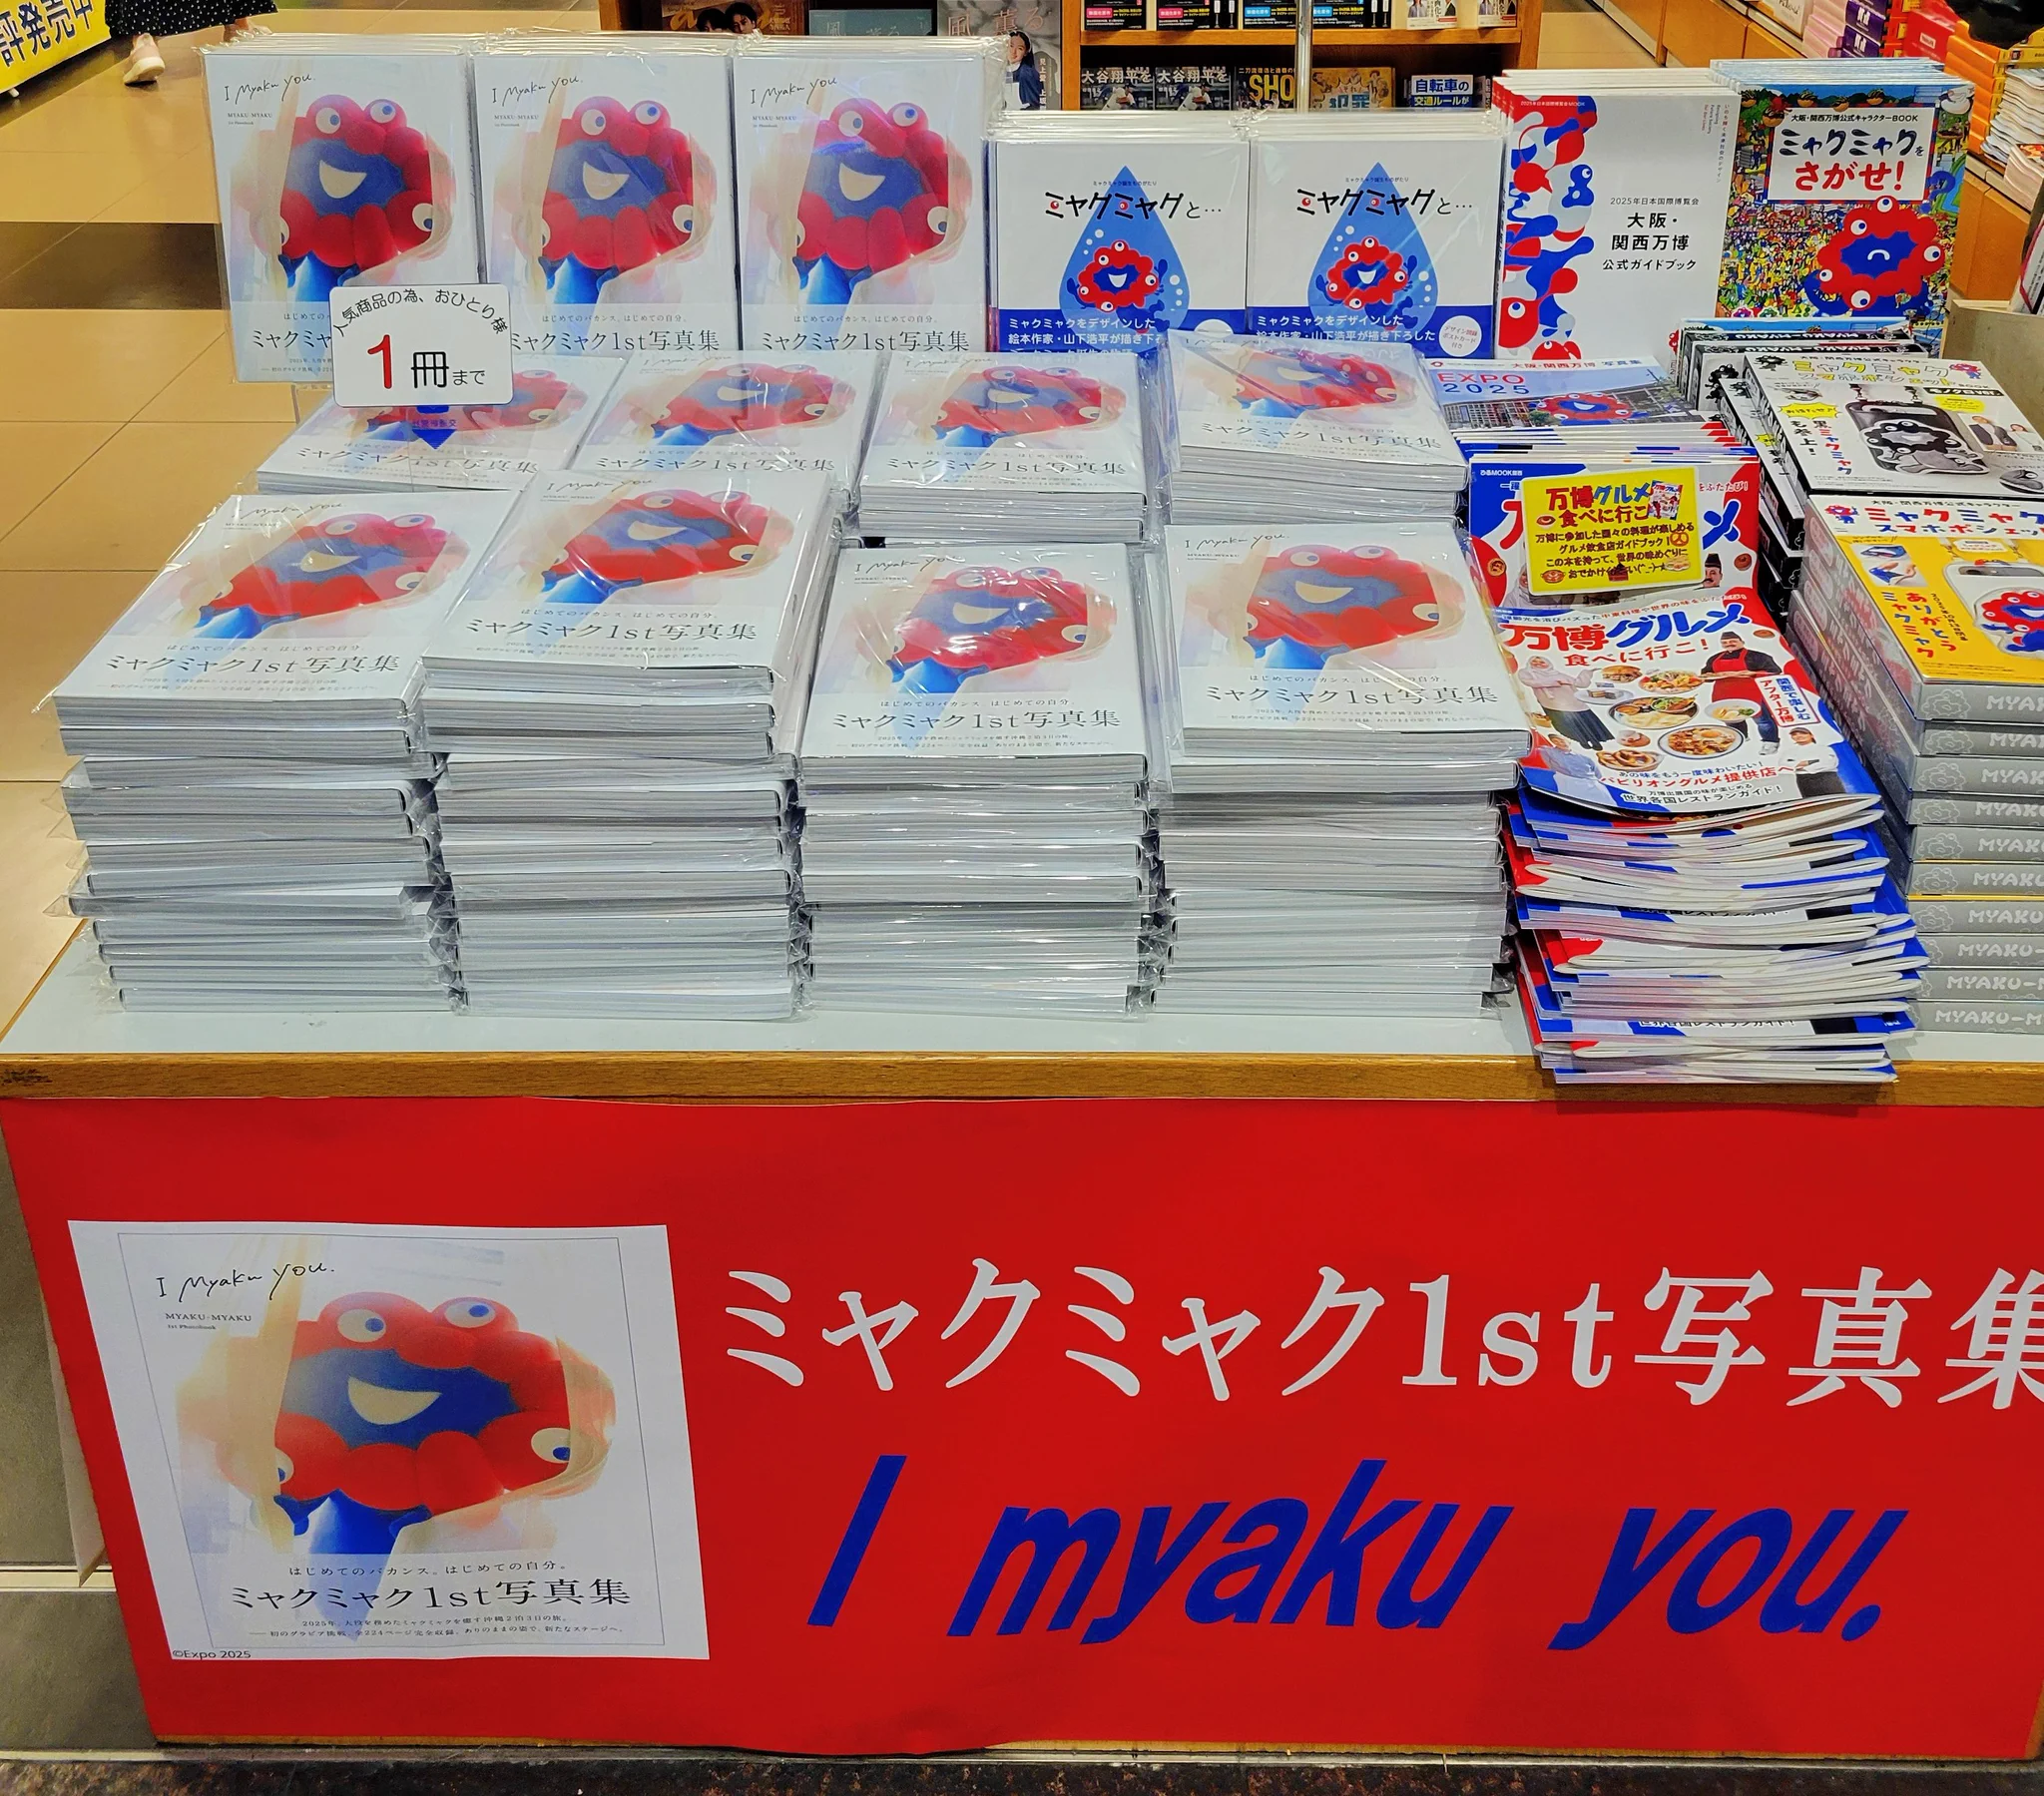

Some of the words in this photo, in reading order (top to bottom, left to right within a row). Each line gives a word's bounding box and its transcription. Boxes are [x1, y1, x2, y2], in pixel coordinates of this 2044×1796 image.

[1082, 70, 1152, 84] 大谷翔平を
[1158, 70, 1229, 84] 大谷翔平を
[1415, 78, 1469, 93] 自転車の
[1779, 128, 1924, 157] ミャクミャクを
[1795, 161, 1905, 192] さがせ！
[1627, 213, 1679, 228] 大阪・
[1611, 234, 1690, 251] 関西万博
[1602, 258, 1697, 271] 公式ガイドブック
[1009, 317, 1156, 329] ミャクミャクをデザインした
[1257, 315, 1404, 326] ミャクミャクをデザインした
[511, 329, 720, 351] ミャクミャク1st写真集
[762, 330, 970, 351] ミャクミャク1st写真集
[1437, 372, 1525, 384] EXPO
[1792, 360, 1948, 378] ミャクミャク
[1443, 382, 1530, 395] 2025
[1546, 481, 1652, 511] 万博グルメ
[1864, 507, 2044, 525] ミャクミャク
[465, 619, 758, 642] ミャクミャク1st写真集
[1498, 602, 1752, 652] 万博グルメ
[1880, 591, 1934, 658] ミャクミャク
[1563, 639, 1709, 668] 食べに行こ！
[106, 654, 402, 675] ミャクミャク1st写真集
[1206, 684, 1498, 705] ミャクミャク1st写真集
[832, 709, 1121, 729] ミャクミャク1st写真集
[1600, 766, 1795, 788] パビリオングルメ提供店へ
[1619, 760, 1765, 778] あの味をもう一度味わいたい！
[1623, 785, 1783, 804] 世界各国レストランガイド！
[156, 1276, 168, 1297] I
[179, 1268, 262, 1303] Myaku
[272, 1262, 334, 1300] you.
[726, 1257, 2044, 1410] ミャクミャク1st写真集
[807, 1454, 907, 1626] I
[946, 1458, 1514, 1644] myaku
[1547, 1508, 1909, 1650] you.
[288, 1561, 568, 1577] はじめてのバカンス。はじめての自分。
[231, 1577, 631, 1609] ミャクミャク1st写真集
[173, 1649, 216, 1660] ©Expo
[220, 1648, 252, 1659] 2025
